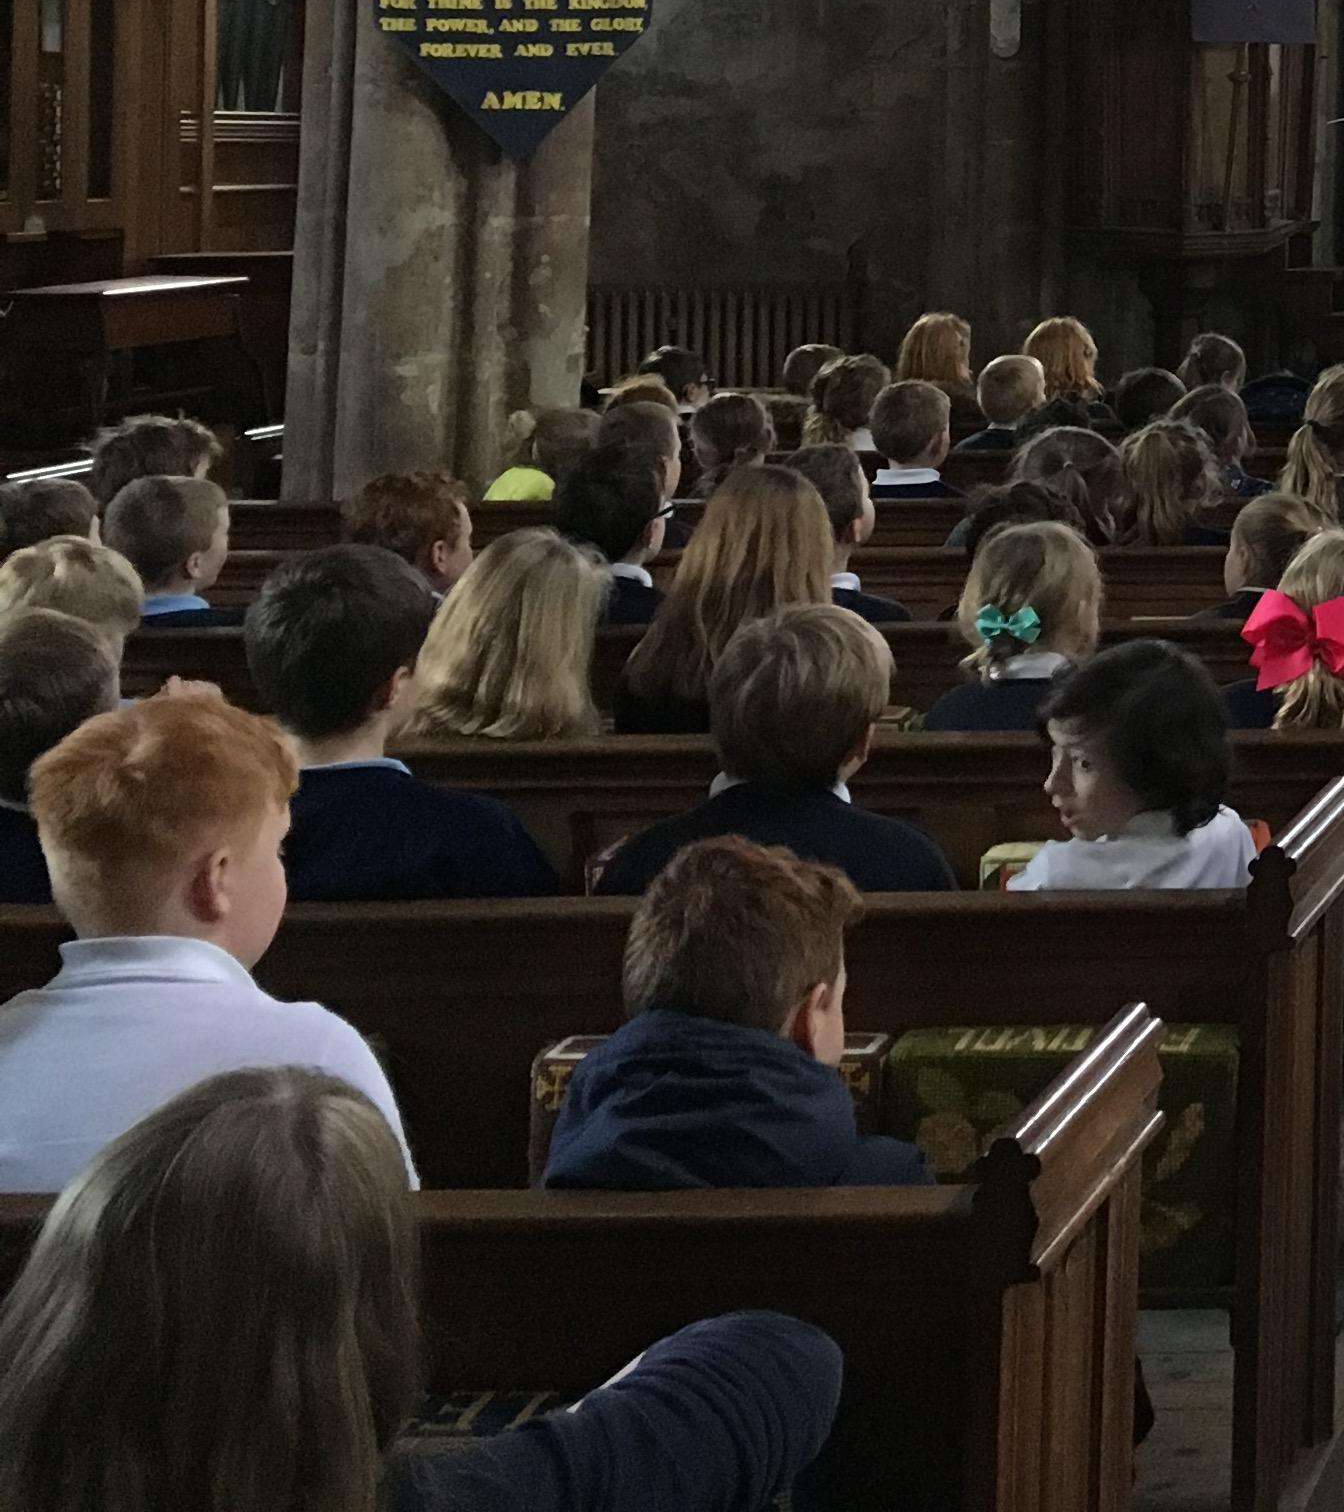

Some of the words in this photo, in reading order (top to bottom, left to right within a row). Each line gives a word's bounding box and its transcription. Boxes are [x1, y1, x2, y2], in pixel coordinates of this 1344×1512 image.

[379, 16, 416, 32] THE
[498, 19, 540, 33] AND
[548, 17, 581, 33] THE
[515, 43, 553, 57] AND
[481, 90, 565, 111] AMEN.
